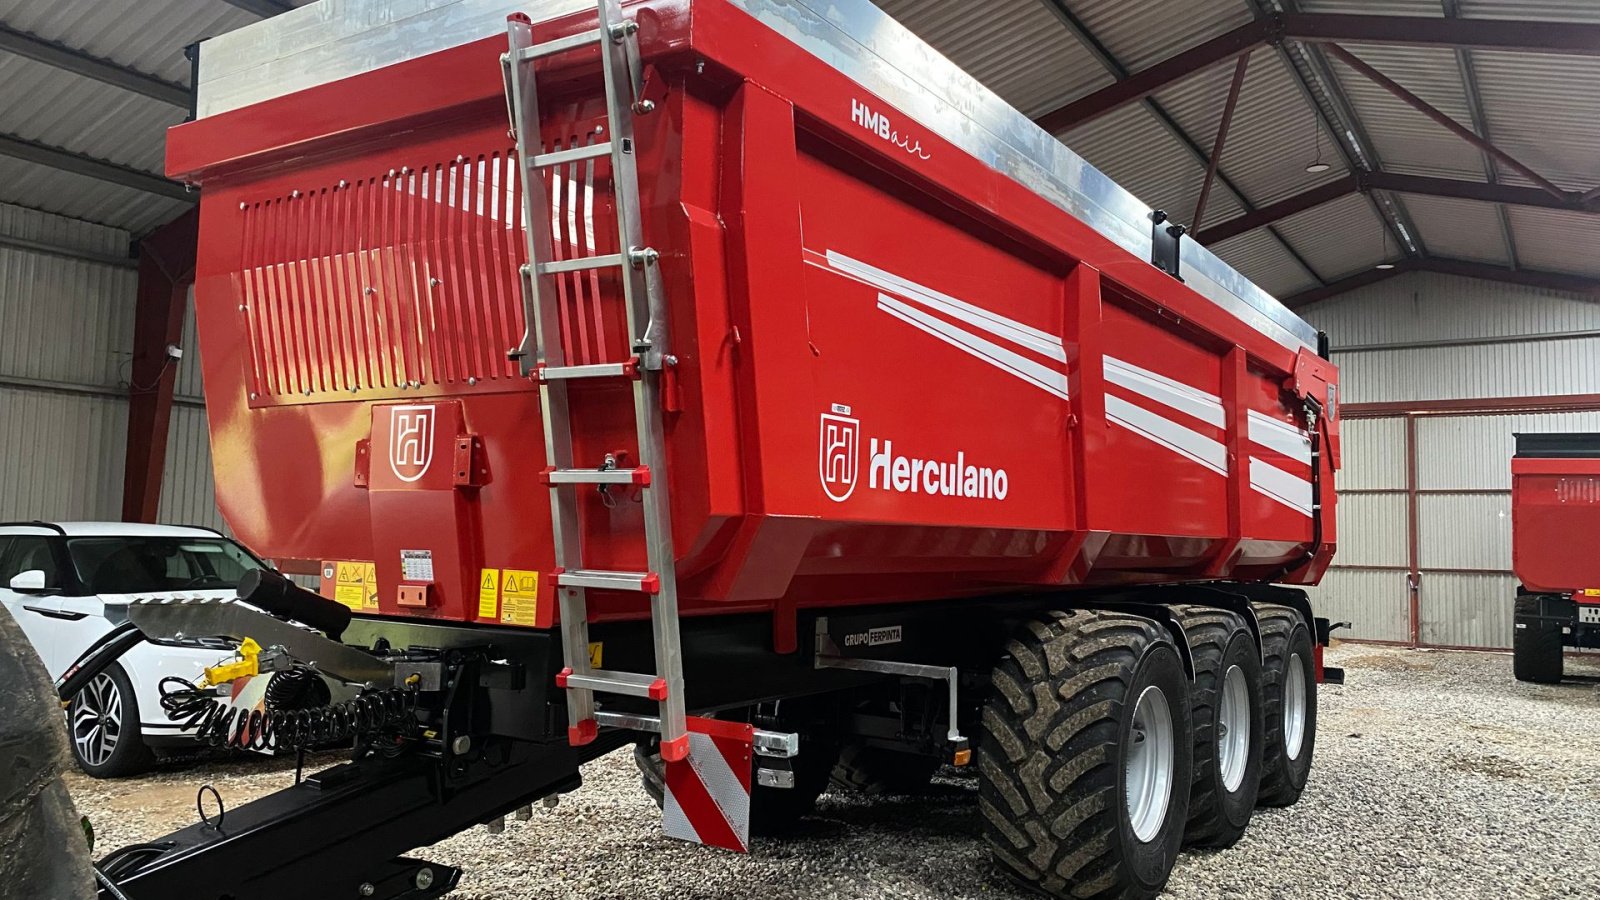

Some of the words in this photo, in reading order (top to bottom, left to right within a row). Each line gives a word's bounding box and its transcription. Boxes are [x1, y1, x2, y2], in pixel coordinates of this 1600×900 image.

[869, 437, 1009, 501] Herculano
[844, 632, 869, 647] GRUPO
[870, 628, 901, 643] FERPINTA
